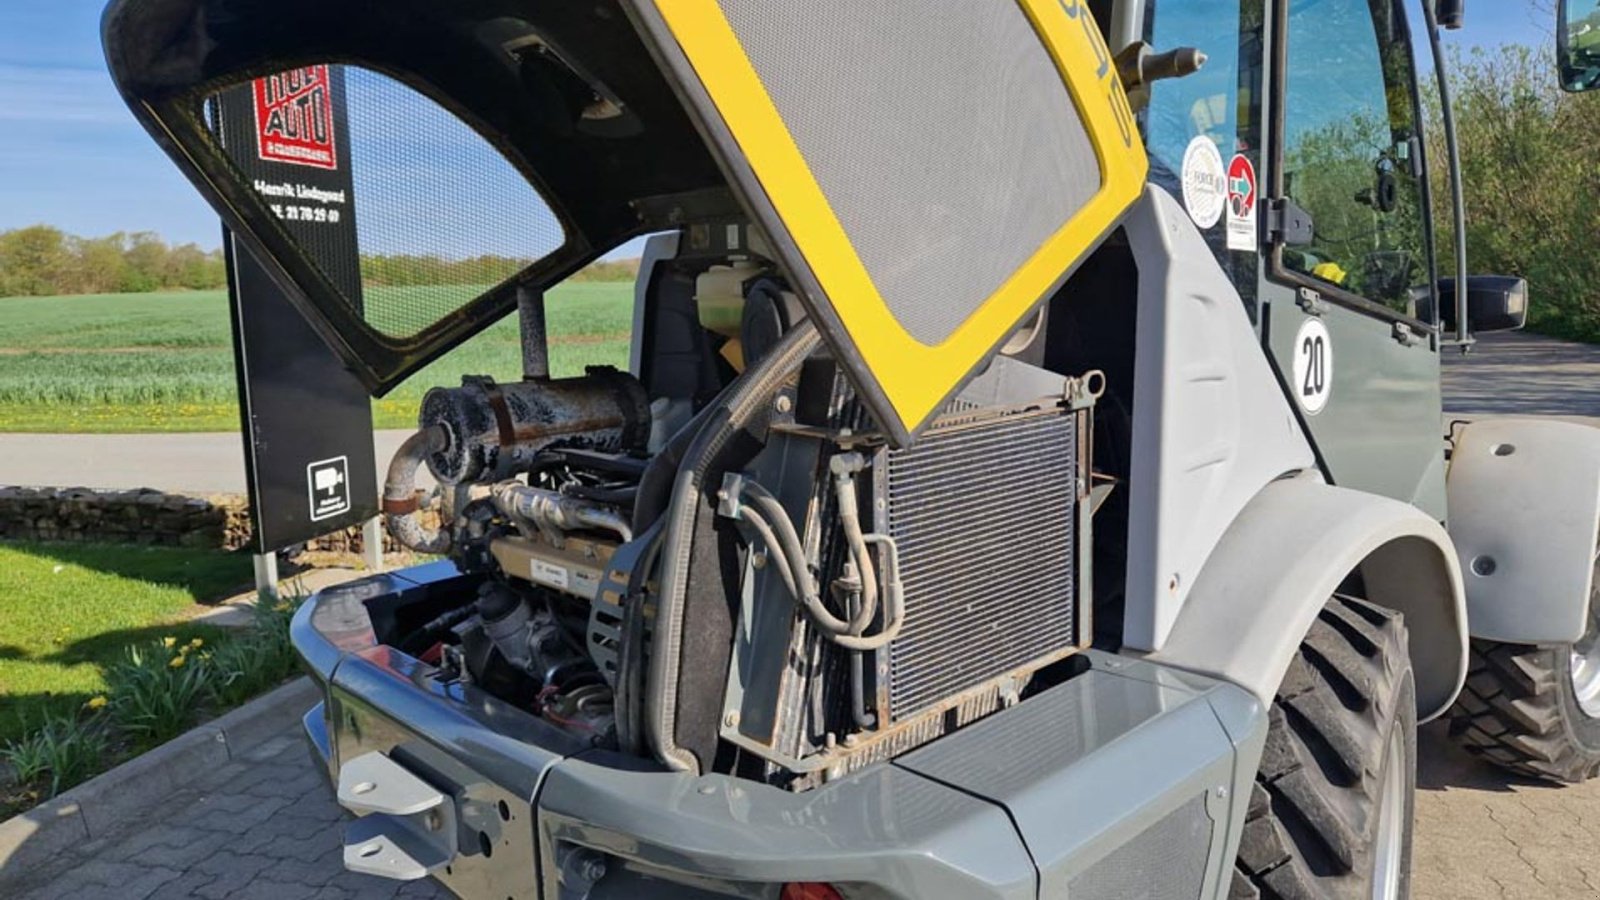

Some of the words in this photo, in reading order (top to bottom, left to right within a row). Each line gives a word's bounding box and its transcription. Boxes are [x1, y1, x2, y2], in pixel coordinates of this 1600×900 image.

[264, 85, 328, 145] AUTO
[254, 179, 295, 198] Henrik
[1303, 335, 1324, 396] 20
